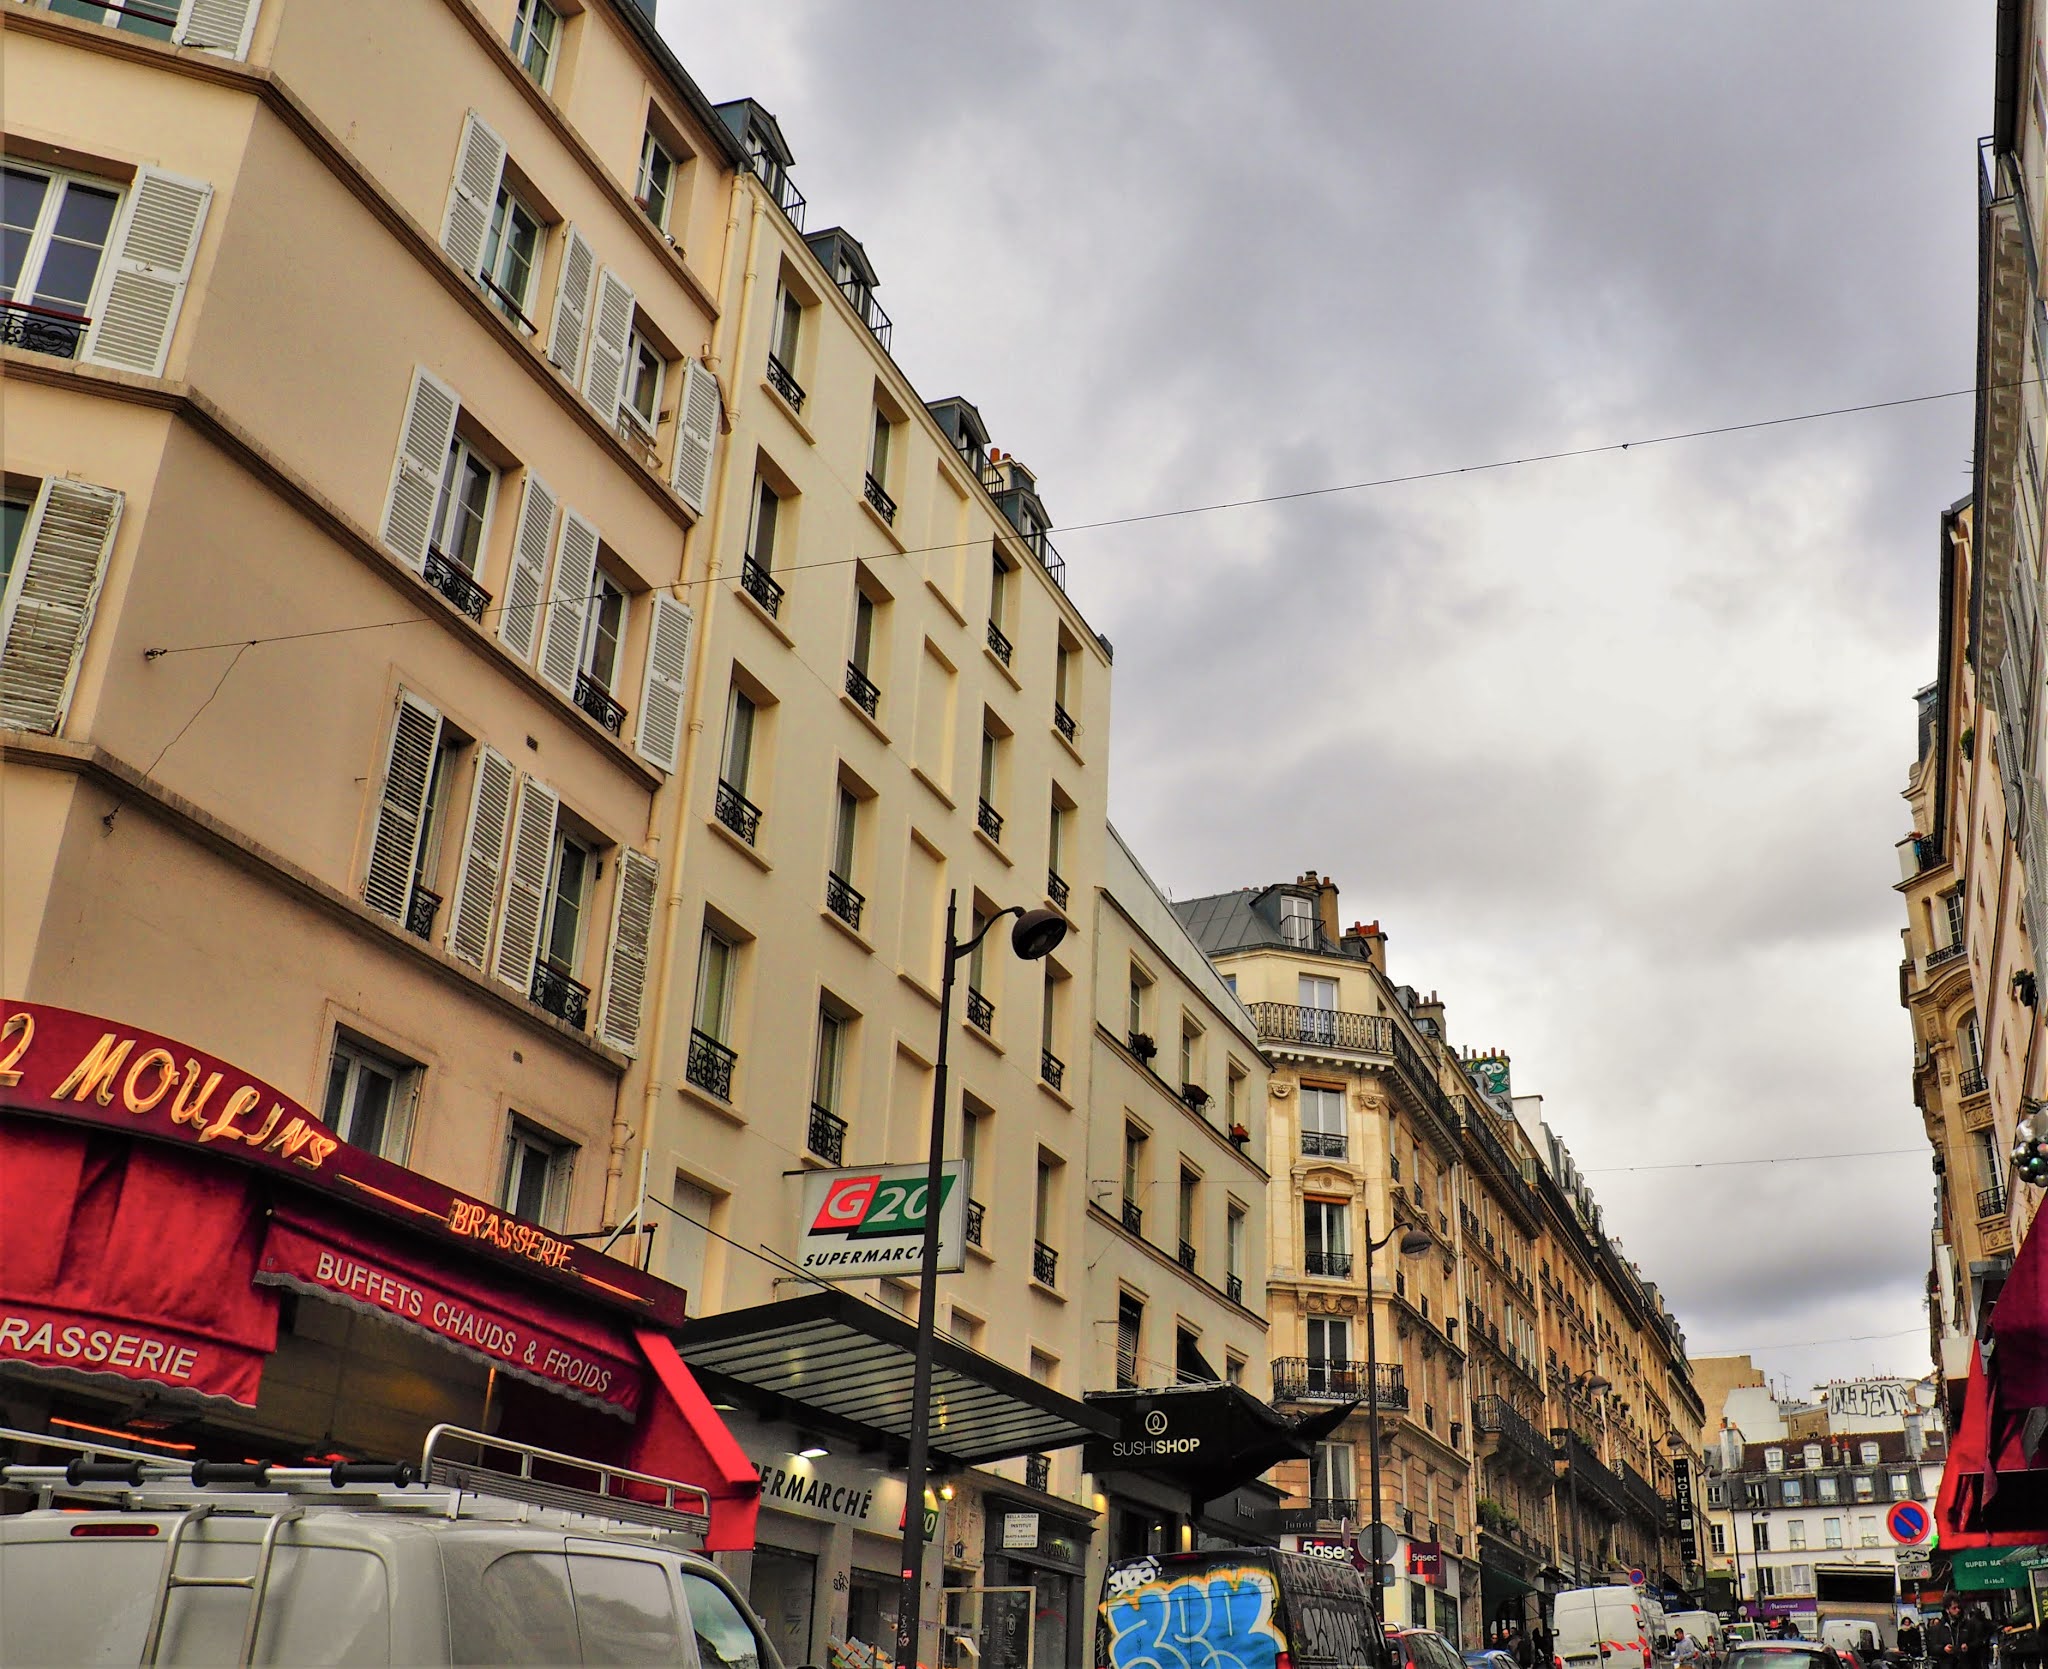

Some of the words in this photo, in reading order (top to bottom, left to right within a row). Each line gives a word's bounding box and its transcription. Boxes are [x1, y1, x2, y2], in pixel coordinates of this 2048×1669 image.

[0, 1012, 35, 1086] 2
[50, 1033, 338, 1170] MOULINS
[449, 1198, 577, 1272] BRASSERIE
[316, 1251, 424, 1317] BUFFETS
[432, 1301, 517, 1357] CHAUDS
[523, 1339, 538, 1366] &
[542, 1348, 612, 1394] FROIDS
[1677, 1476, 1689, 1512] HOTEL
[1682, 1520, 1691, 1529] 29
[1411, 1553, 1438, 1563] 5asec
[1965, 1560, 1988, 1568] SUPER
[2020, 1558, 2039, 1567] SUPER
